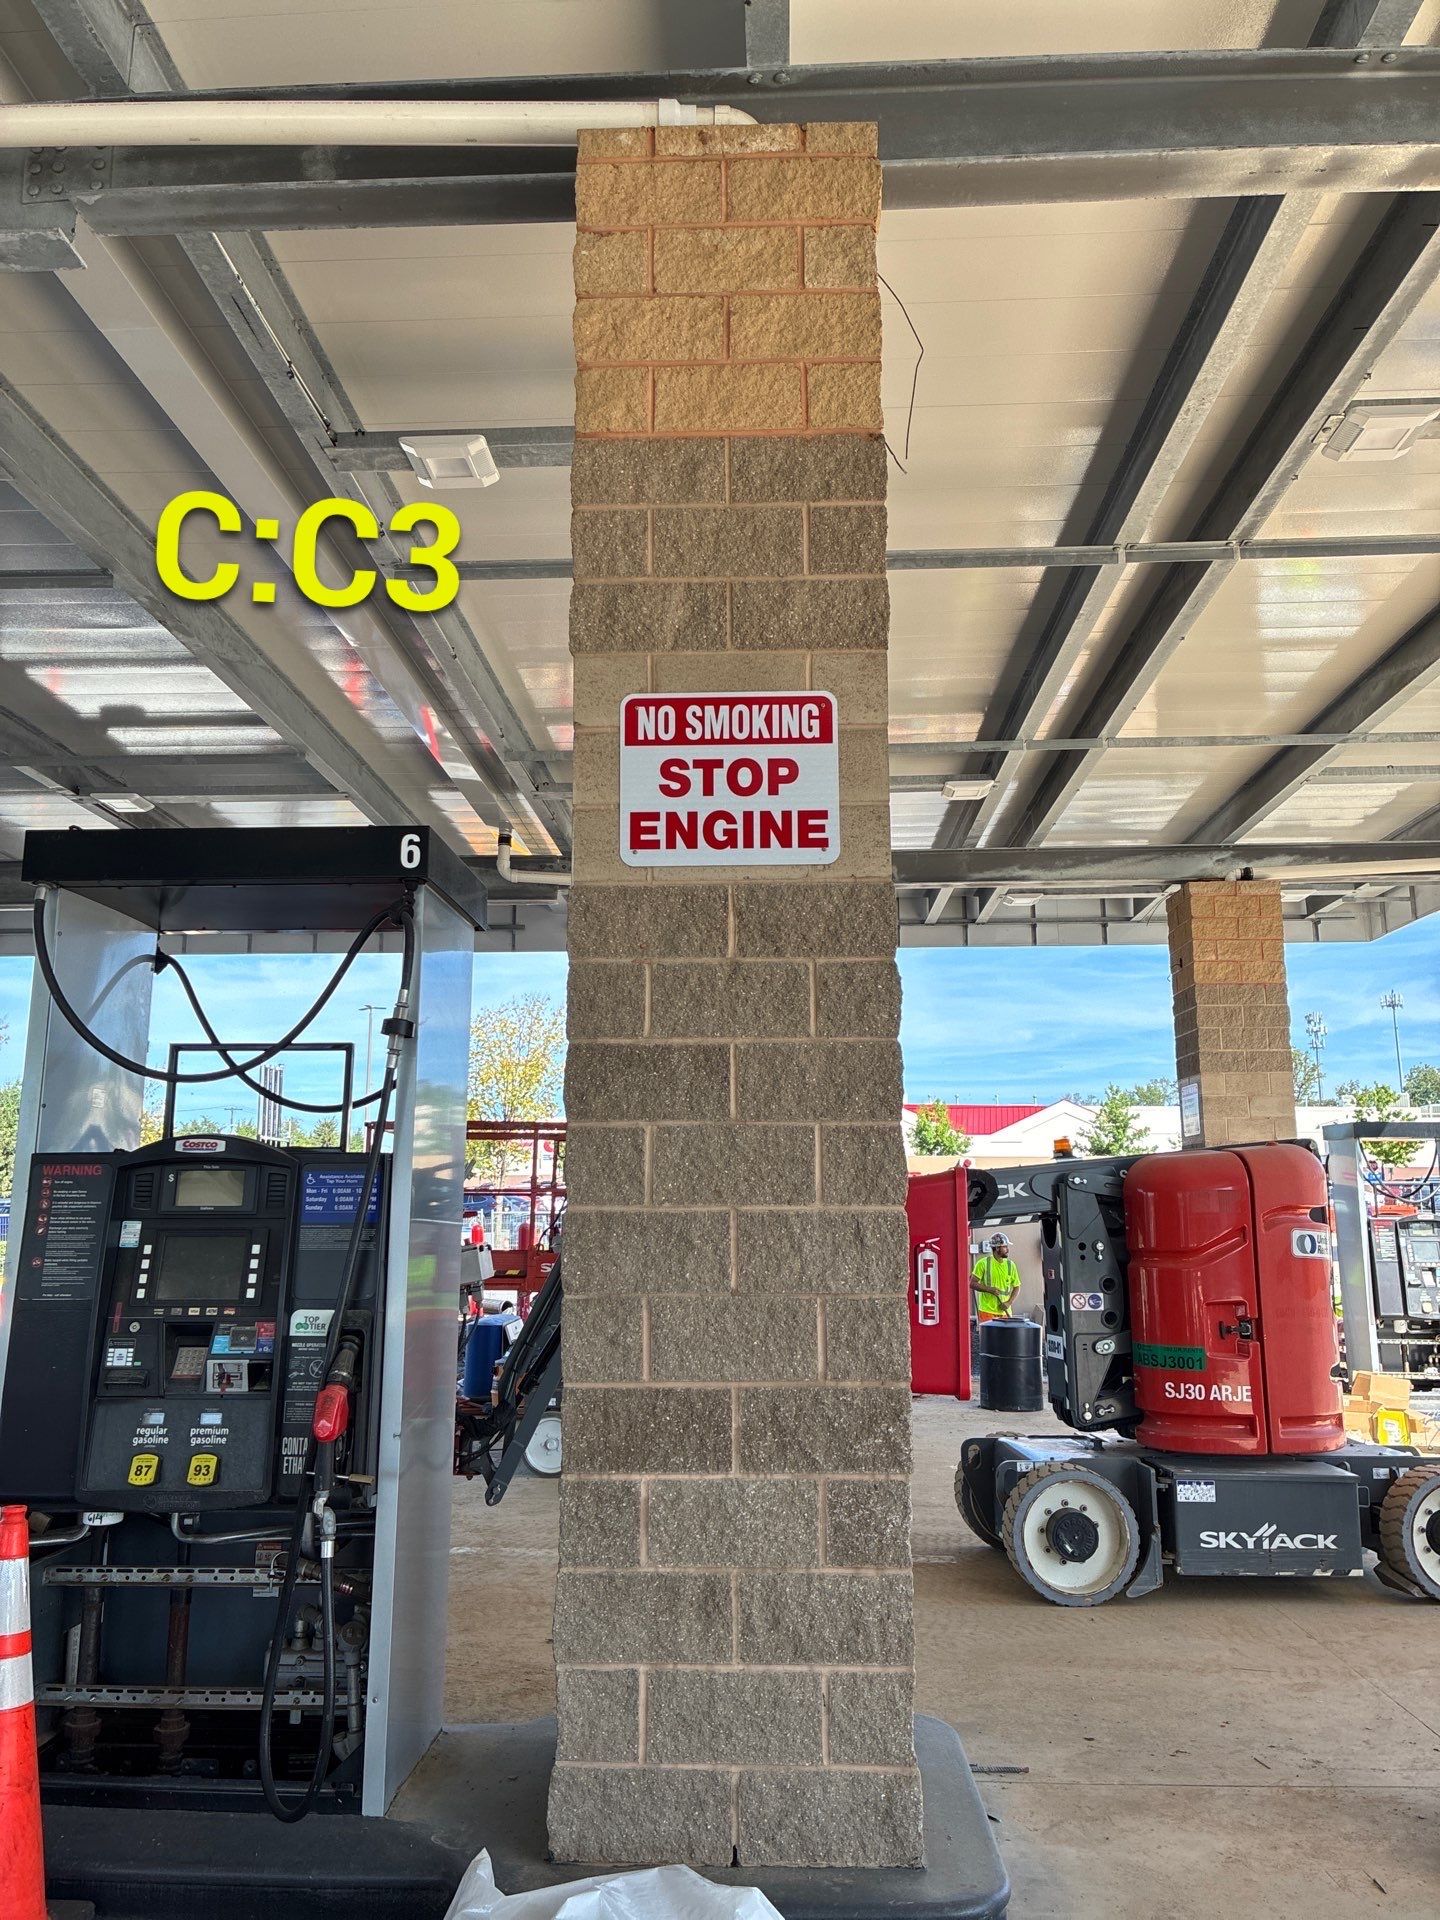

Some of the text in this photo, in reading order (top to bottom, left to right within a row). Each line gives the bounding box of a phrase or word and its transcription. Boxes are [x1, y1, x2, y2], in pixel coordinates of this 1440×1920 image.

[637, 703, 820, 741] NO SMOKING
[658, 757, 800, 798] STOP
[629, 809, 829, 850] ENGINE
[400, 833, 421, 869] 6
[43, 1165, 102, 1176] WARNING
[168, 1173, 175, 1182] $
[922, 1259, 936, 1320] FIRE
[1136, 1352, 1203, 1370] ABSJ3001
[1164, 1382, 1252, 1402] SJ30 ARJE
[132, 1435, 169, 1446] gasoline
[136, 1426, 168, 1437] regular
[190, 1426, 229, 1437] premium
[190, 1435, 227, 1446] gasoline
[282, 1437, 309, 1455] CONTA
[134, 1464, 152, 1477] 87
[193, 1464, 211, 1477] 93
[1200, 1522, 1338, 1550] SKYJACK
